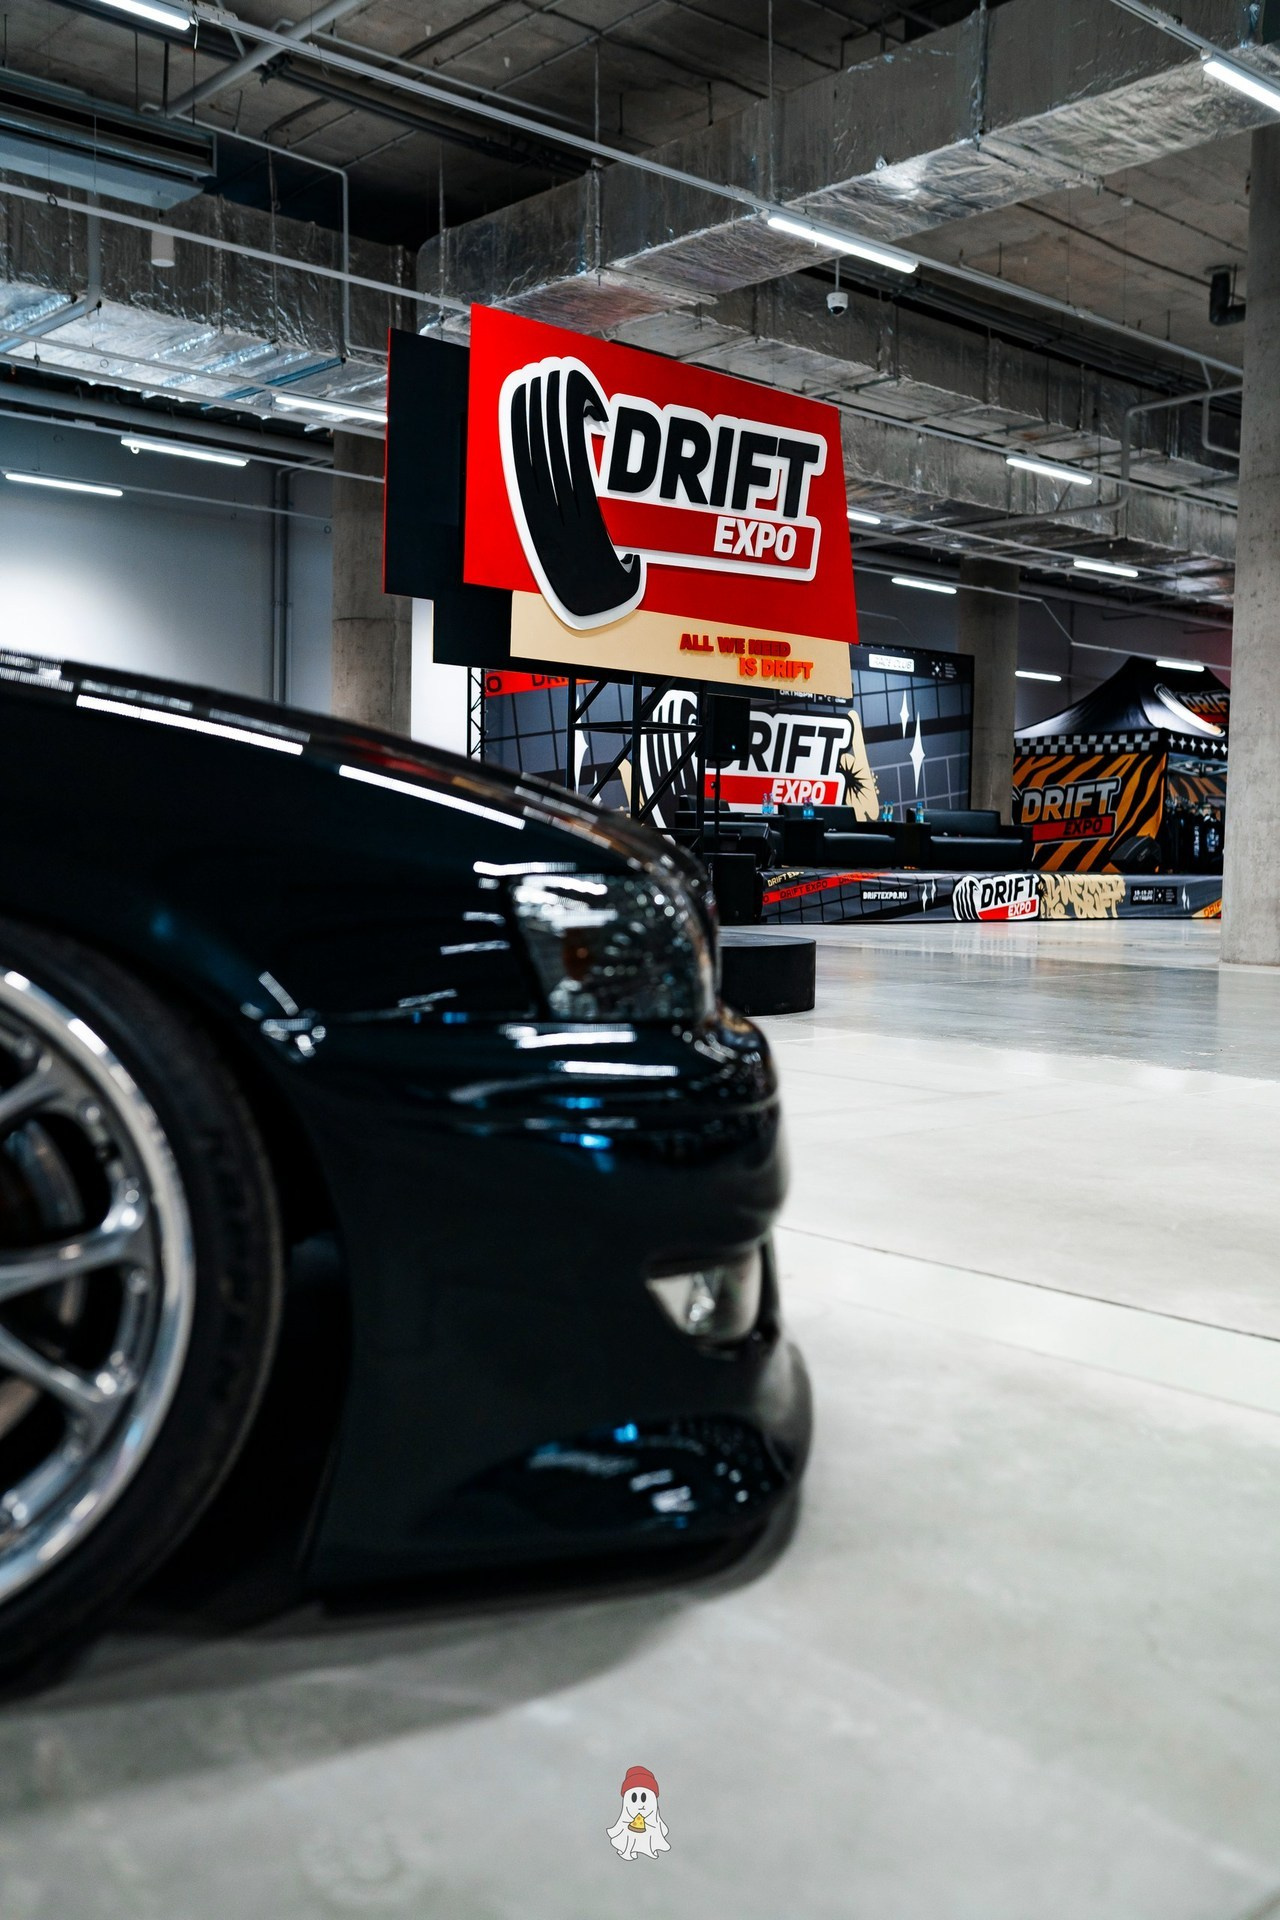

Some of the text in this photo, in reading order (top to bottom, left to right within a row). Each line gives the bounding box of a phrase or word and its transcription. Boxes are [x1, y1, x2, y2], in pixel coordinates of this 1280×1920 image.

[607, 406, 820, 519] DRIFT
[713, 515, 797, 562] EXPO
[680, 633, 791, 658] ALL WE NEED
[739, 657, 814, 680] IS DRIFT
[1180, 692, 1230, 714] DRIF
[706, 719, 845, 776] RIFT
[771, 778, 826, 806] EXPO
[1021, 781, 1117, 824] DRIFT
[1063, 818, 1103, 836] EXPO
[767, 873, 787, 888] DRIFT
[780, 886, 804, 899] DRIFT
[805, 880, 828, 892] EXPO
[980, 875, 1036, 909] DRIFT
[862, 891, 908, 900] DRIFTEXPO.RU
[1008, 901, 1031, 917] EXPO
